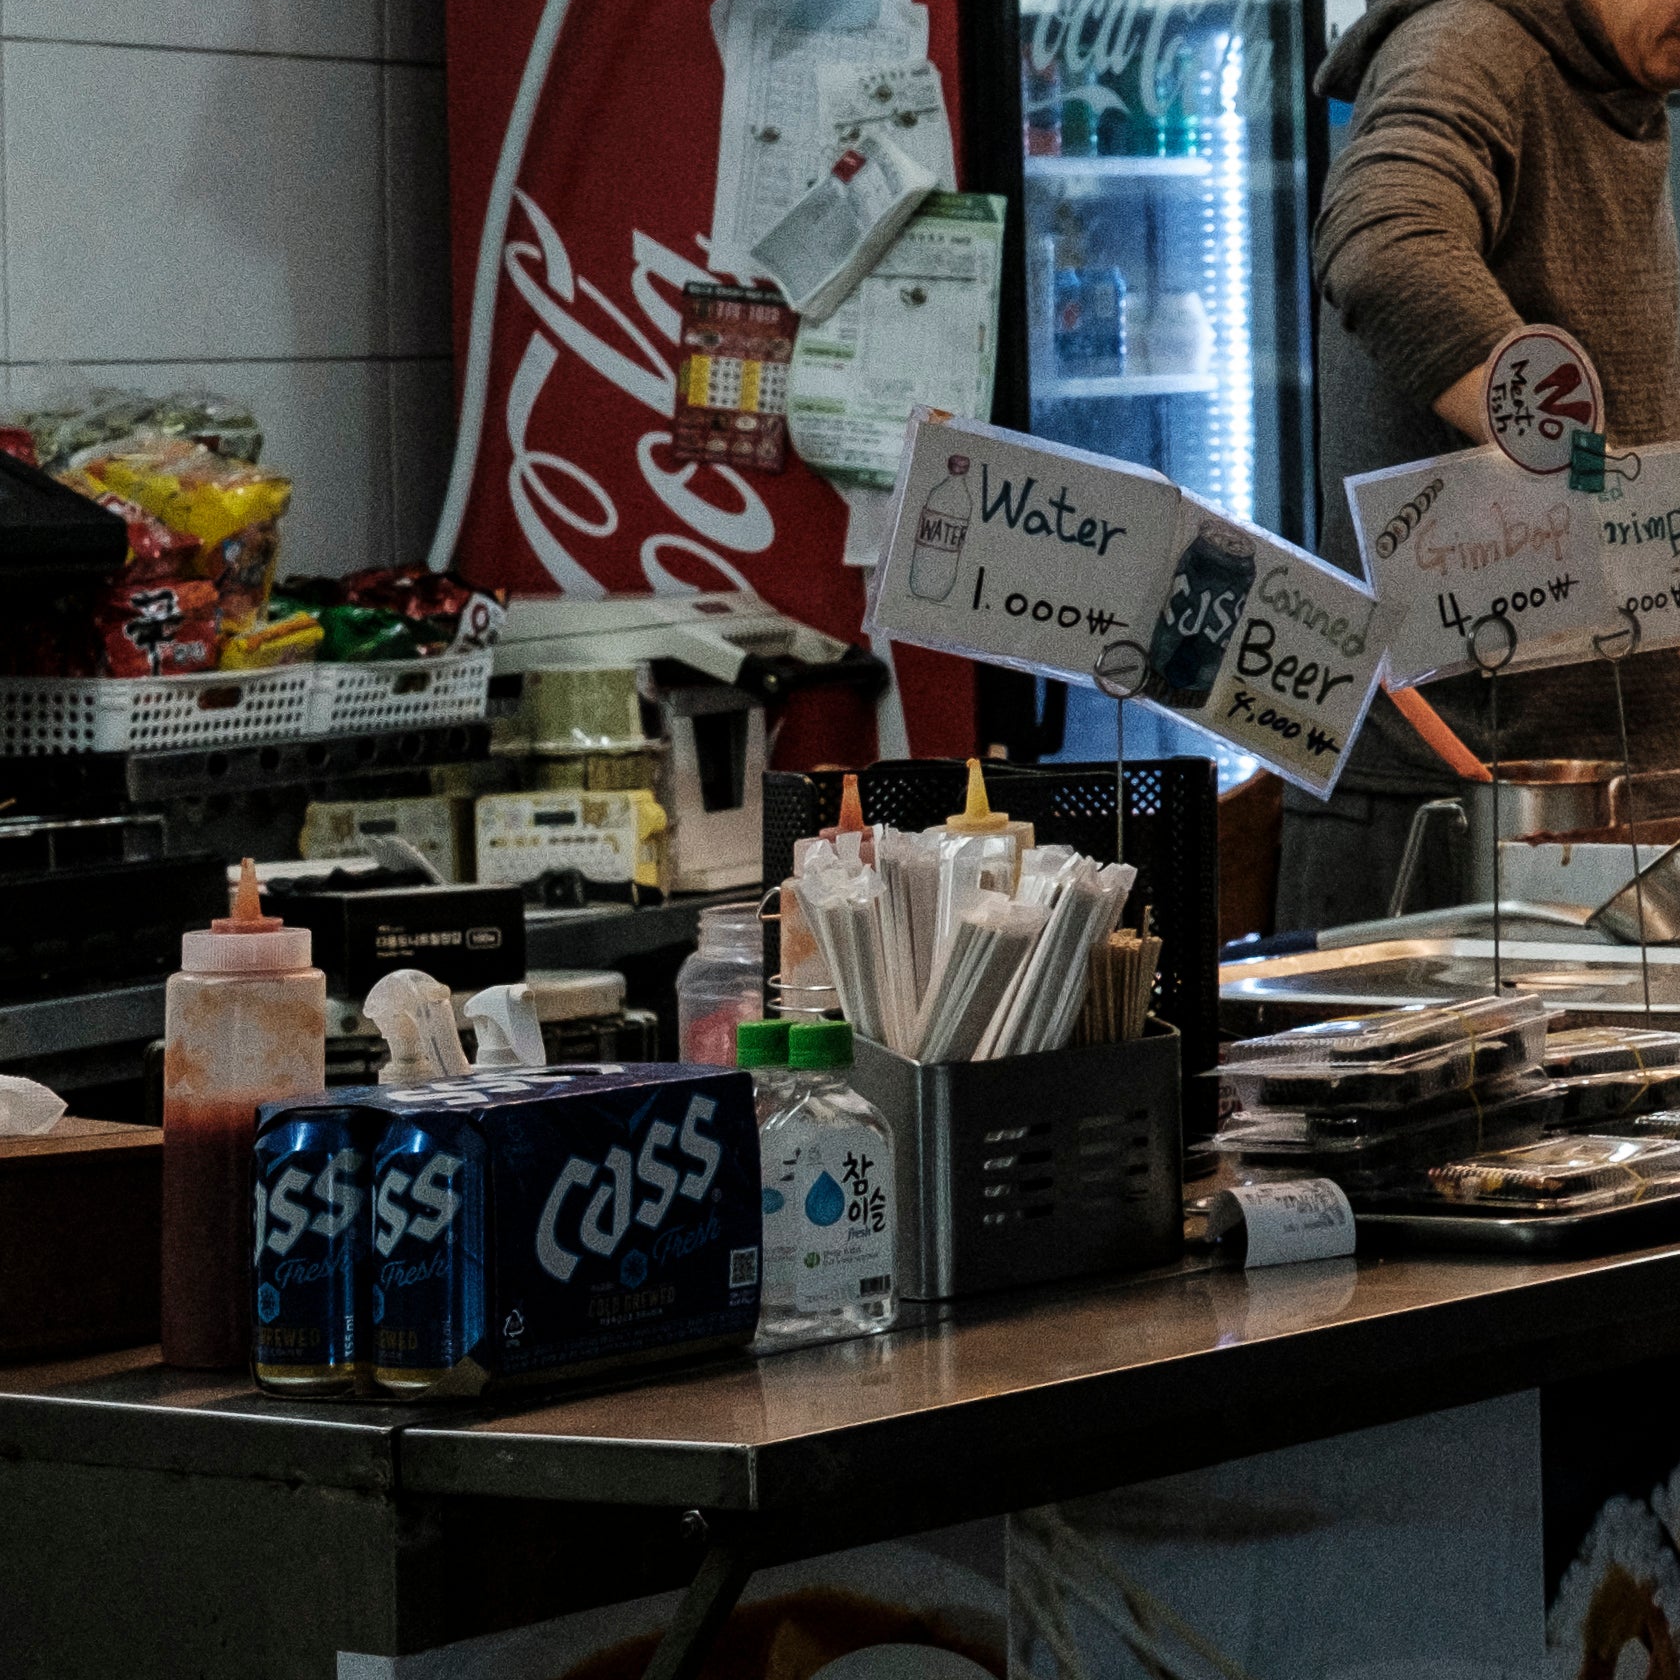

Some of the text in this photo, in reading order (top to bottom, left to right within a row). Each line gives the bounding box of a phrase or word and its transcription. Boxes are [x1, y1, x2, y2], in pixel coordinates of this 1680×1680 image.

[918, 517, 968, 548] WATER
[979, 462, 1127, 557] Water
[1236, 616, 1354, 707] Beer
